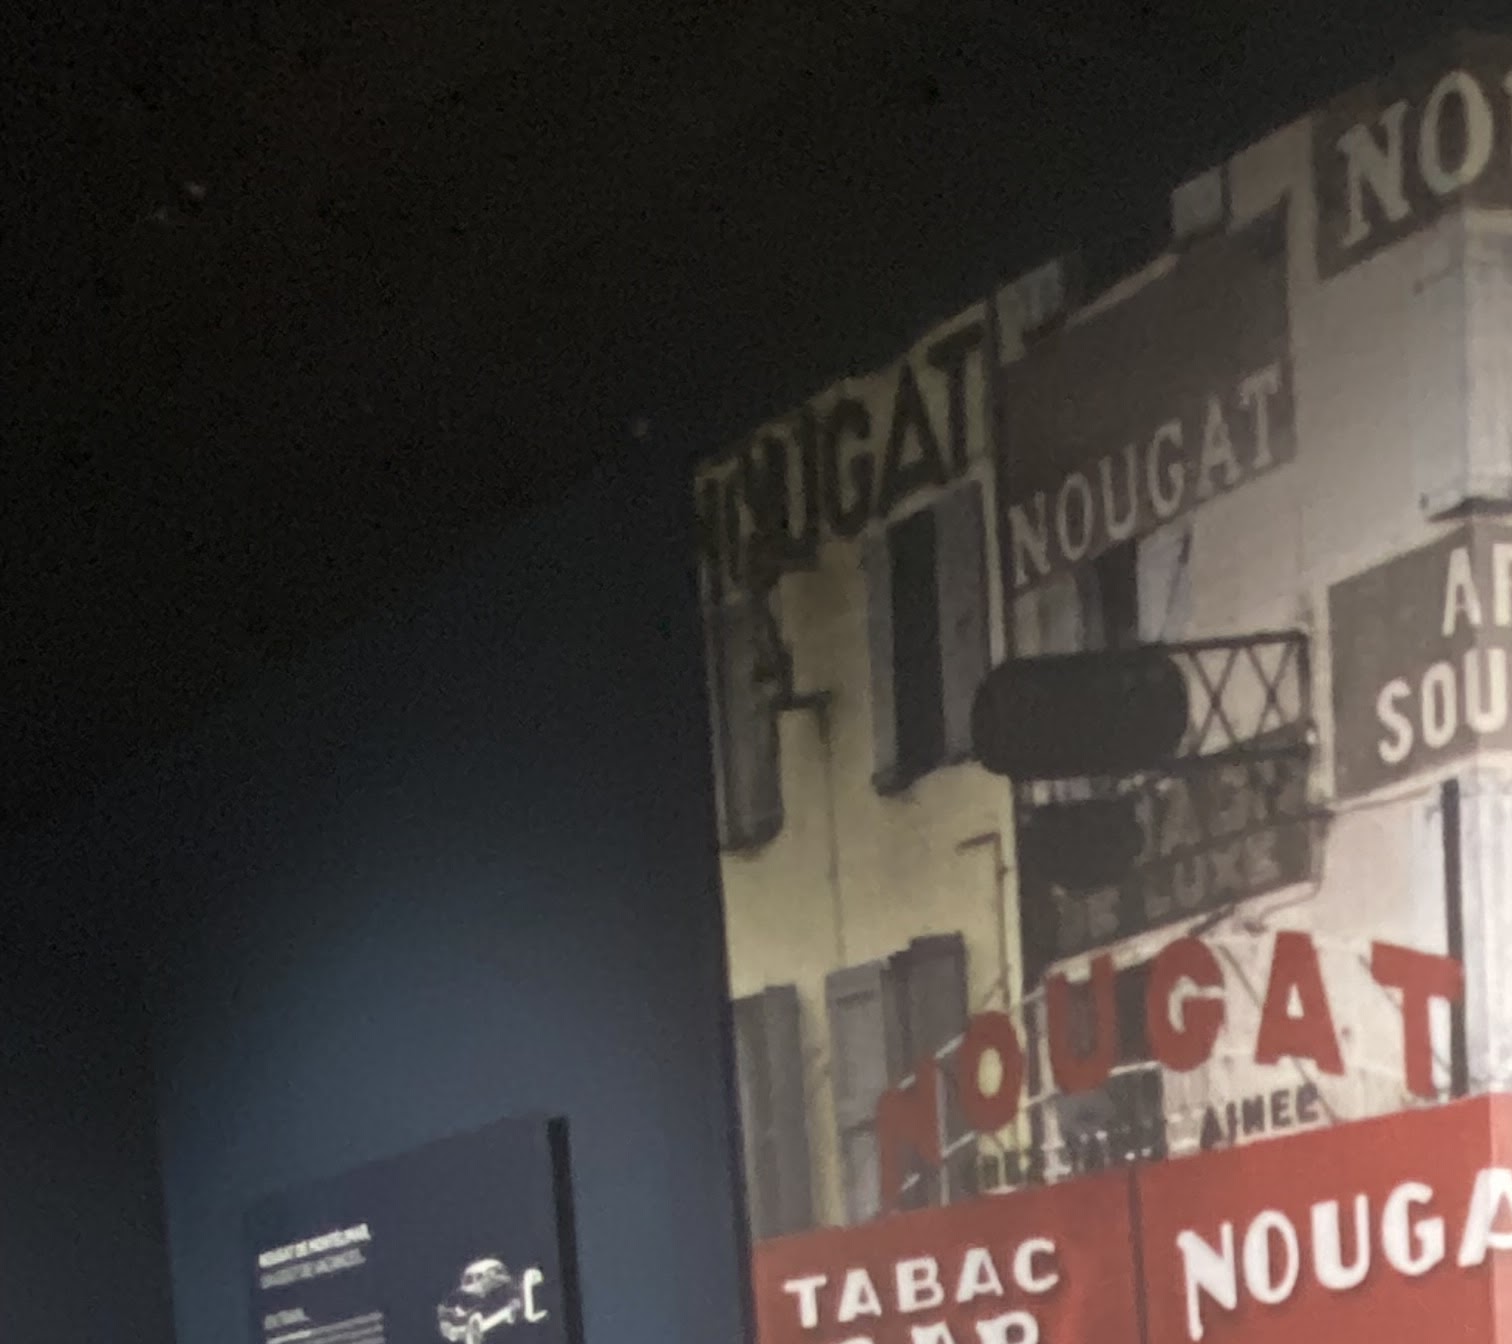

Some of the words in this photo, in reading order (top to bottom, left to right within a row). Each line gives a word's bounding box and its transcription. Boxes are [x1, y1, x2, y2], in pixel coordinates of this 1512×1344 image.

[1007, 363, 1282, 590] NOUGAT
[876, 931, 1465, 1206] NOUGAT
[785, 1236, 1060, 1329] TABAC
